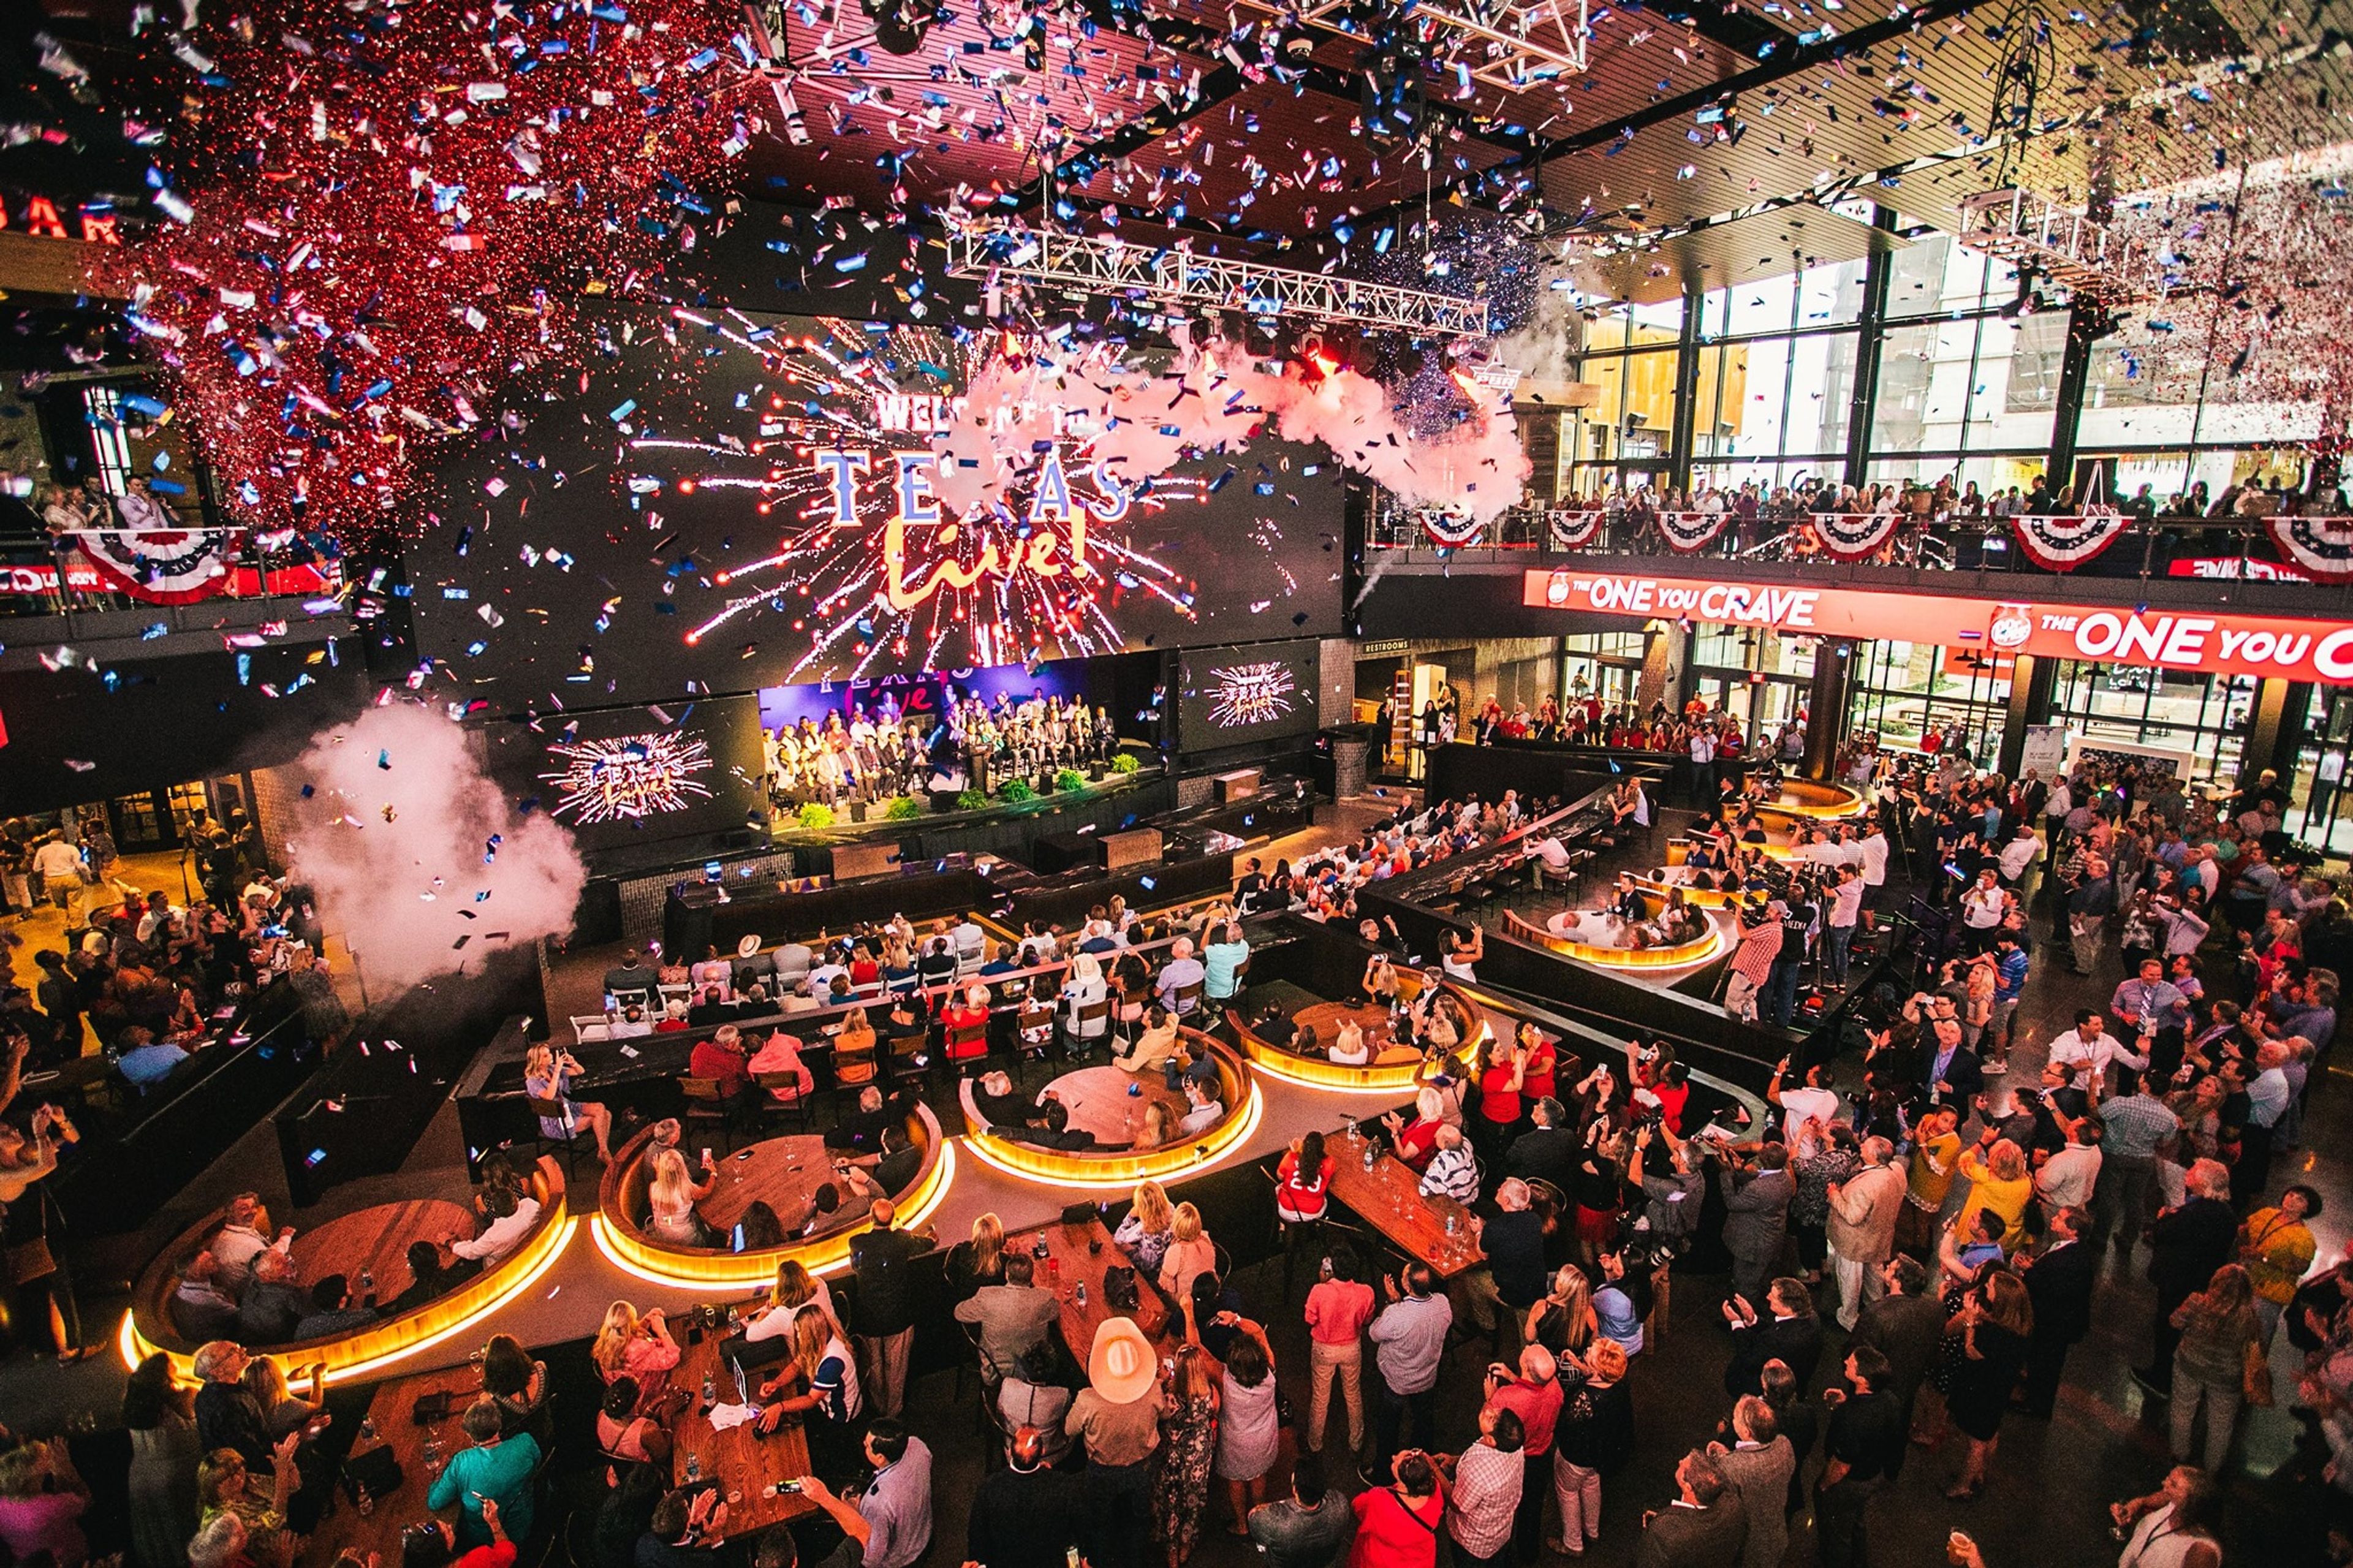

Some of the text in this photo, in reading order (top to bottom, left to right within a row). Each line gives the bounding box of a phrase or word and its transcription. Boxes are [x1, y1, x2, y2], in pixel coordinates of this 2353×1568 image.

[876, 394, 1037, 433] WELCME
[884, 501, 1088, 610] Live!
[1572, 580, 1593, 591] THE
[1590, 577, 1658, 612] ONE
[1658, 588, 1699, 609] YOU
[1700, 585, 1819, 626] CRAVE
[1365, 640, 1408, 653] RESTROOMS
[2040, 615, 2078, 632] THE
[2075, 613, 2216, 665] ONE
[2218, 629, 2312, 665] YOU
